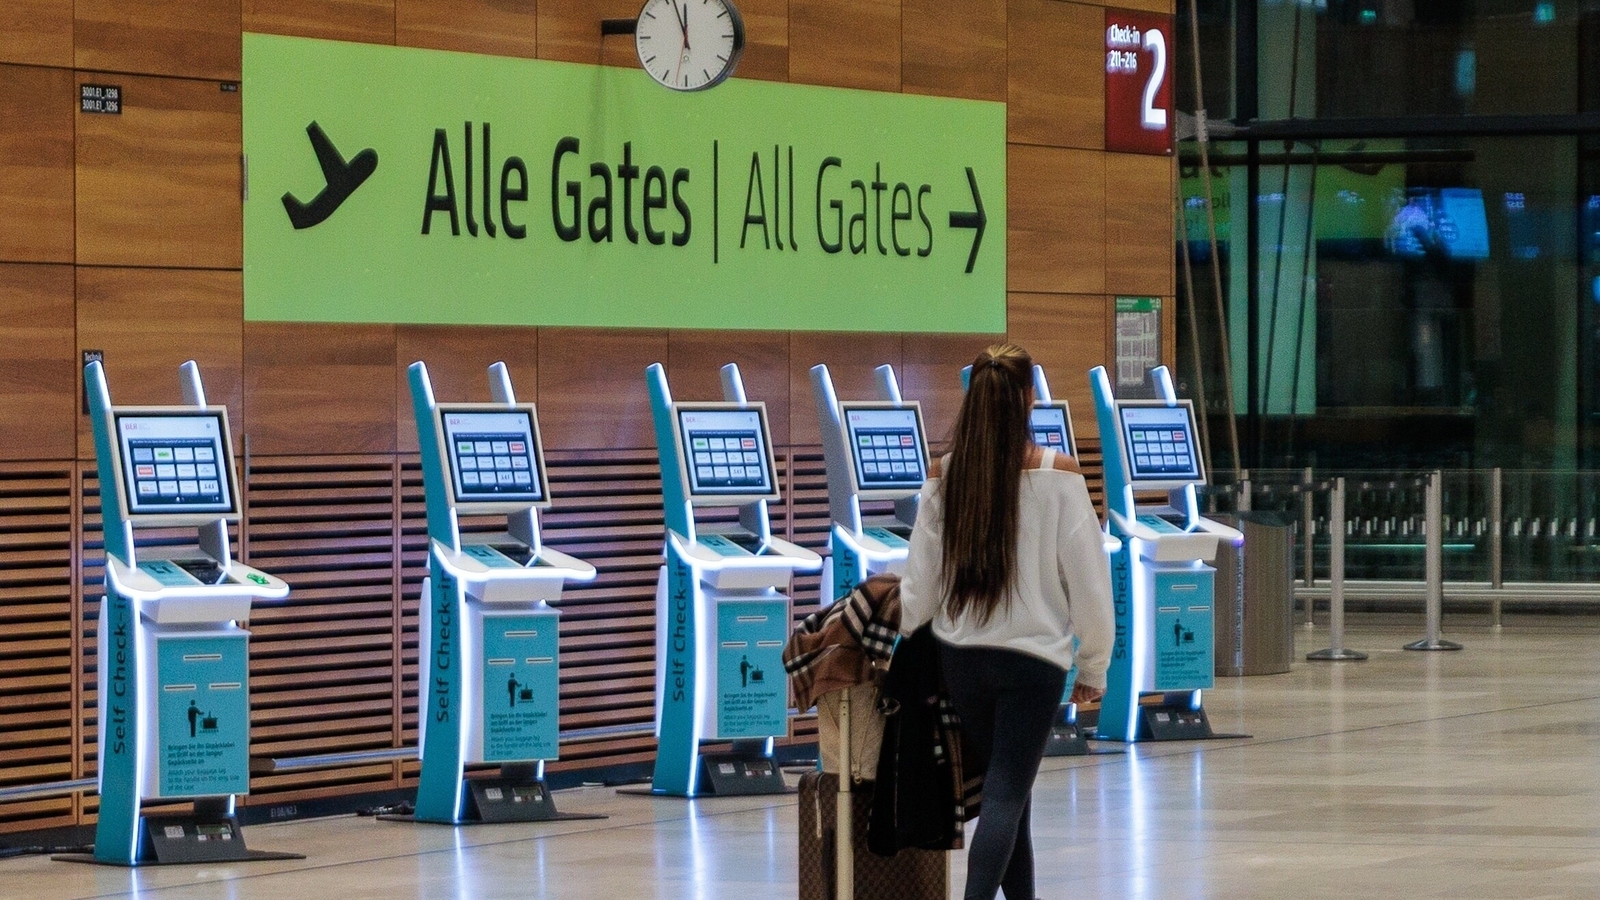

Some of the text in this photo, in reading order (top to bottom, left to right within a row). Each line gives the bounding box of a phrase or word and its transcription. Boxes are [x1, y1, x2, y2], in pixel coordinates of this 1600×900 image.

[1109, 23, 1141, 45] Check-in
[1142, 28, 1167, 127] 2
[420, 120, 933, 258] Alle Gates All Gates
[436, 678, 449, 723] Self
[672, 658, 685, 702] Self
[113, 704, 125, 754] Self
